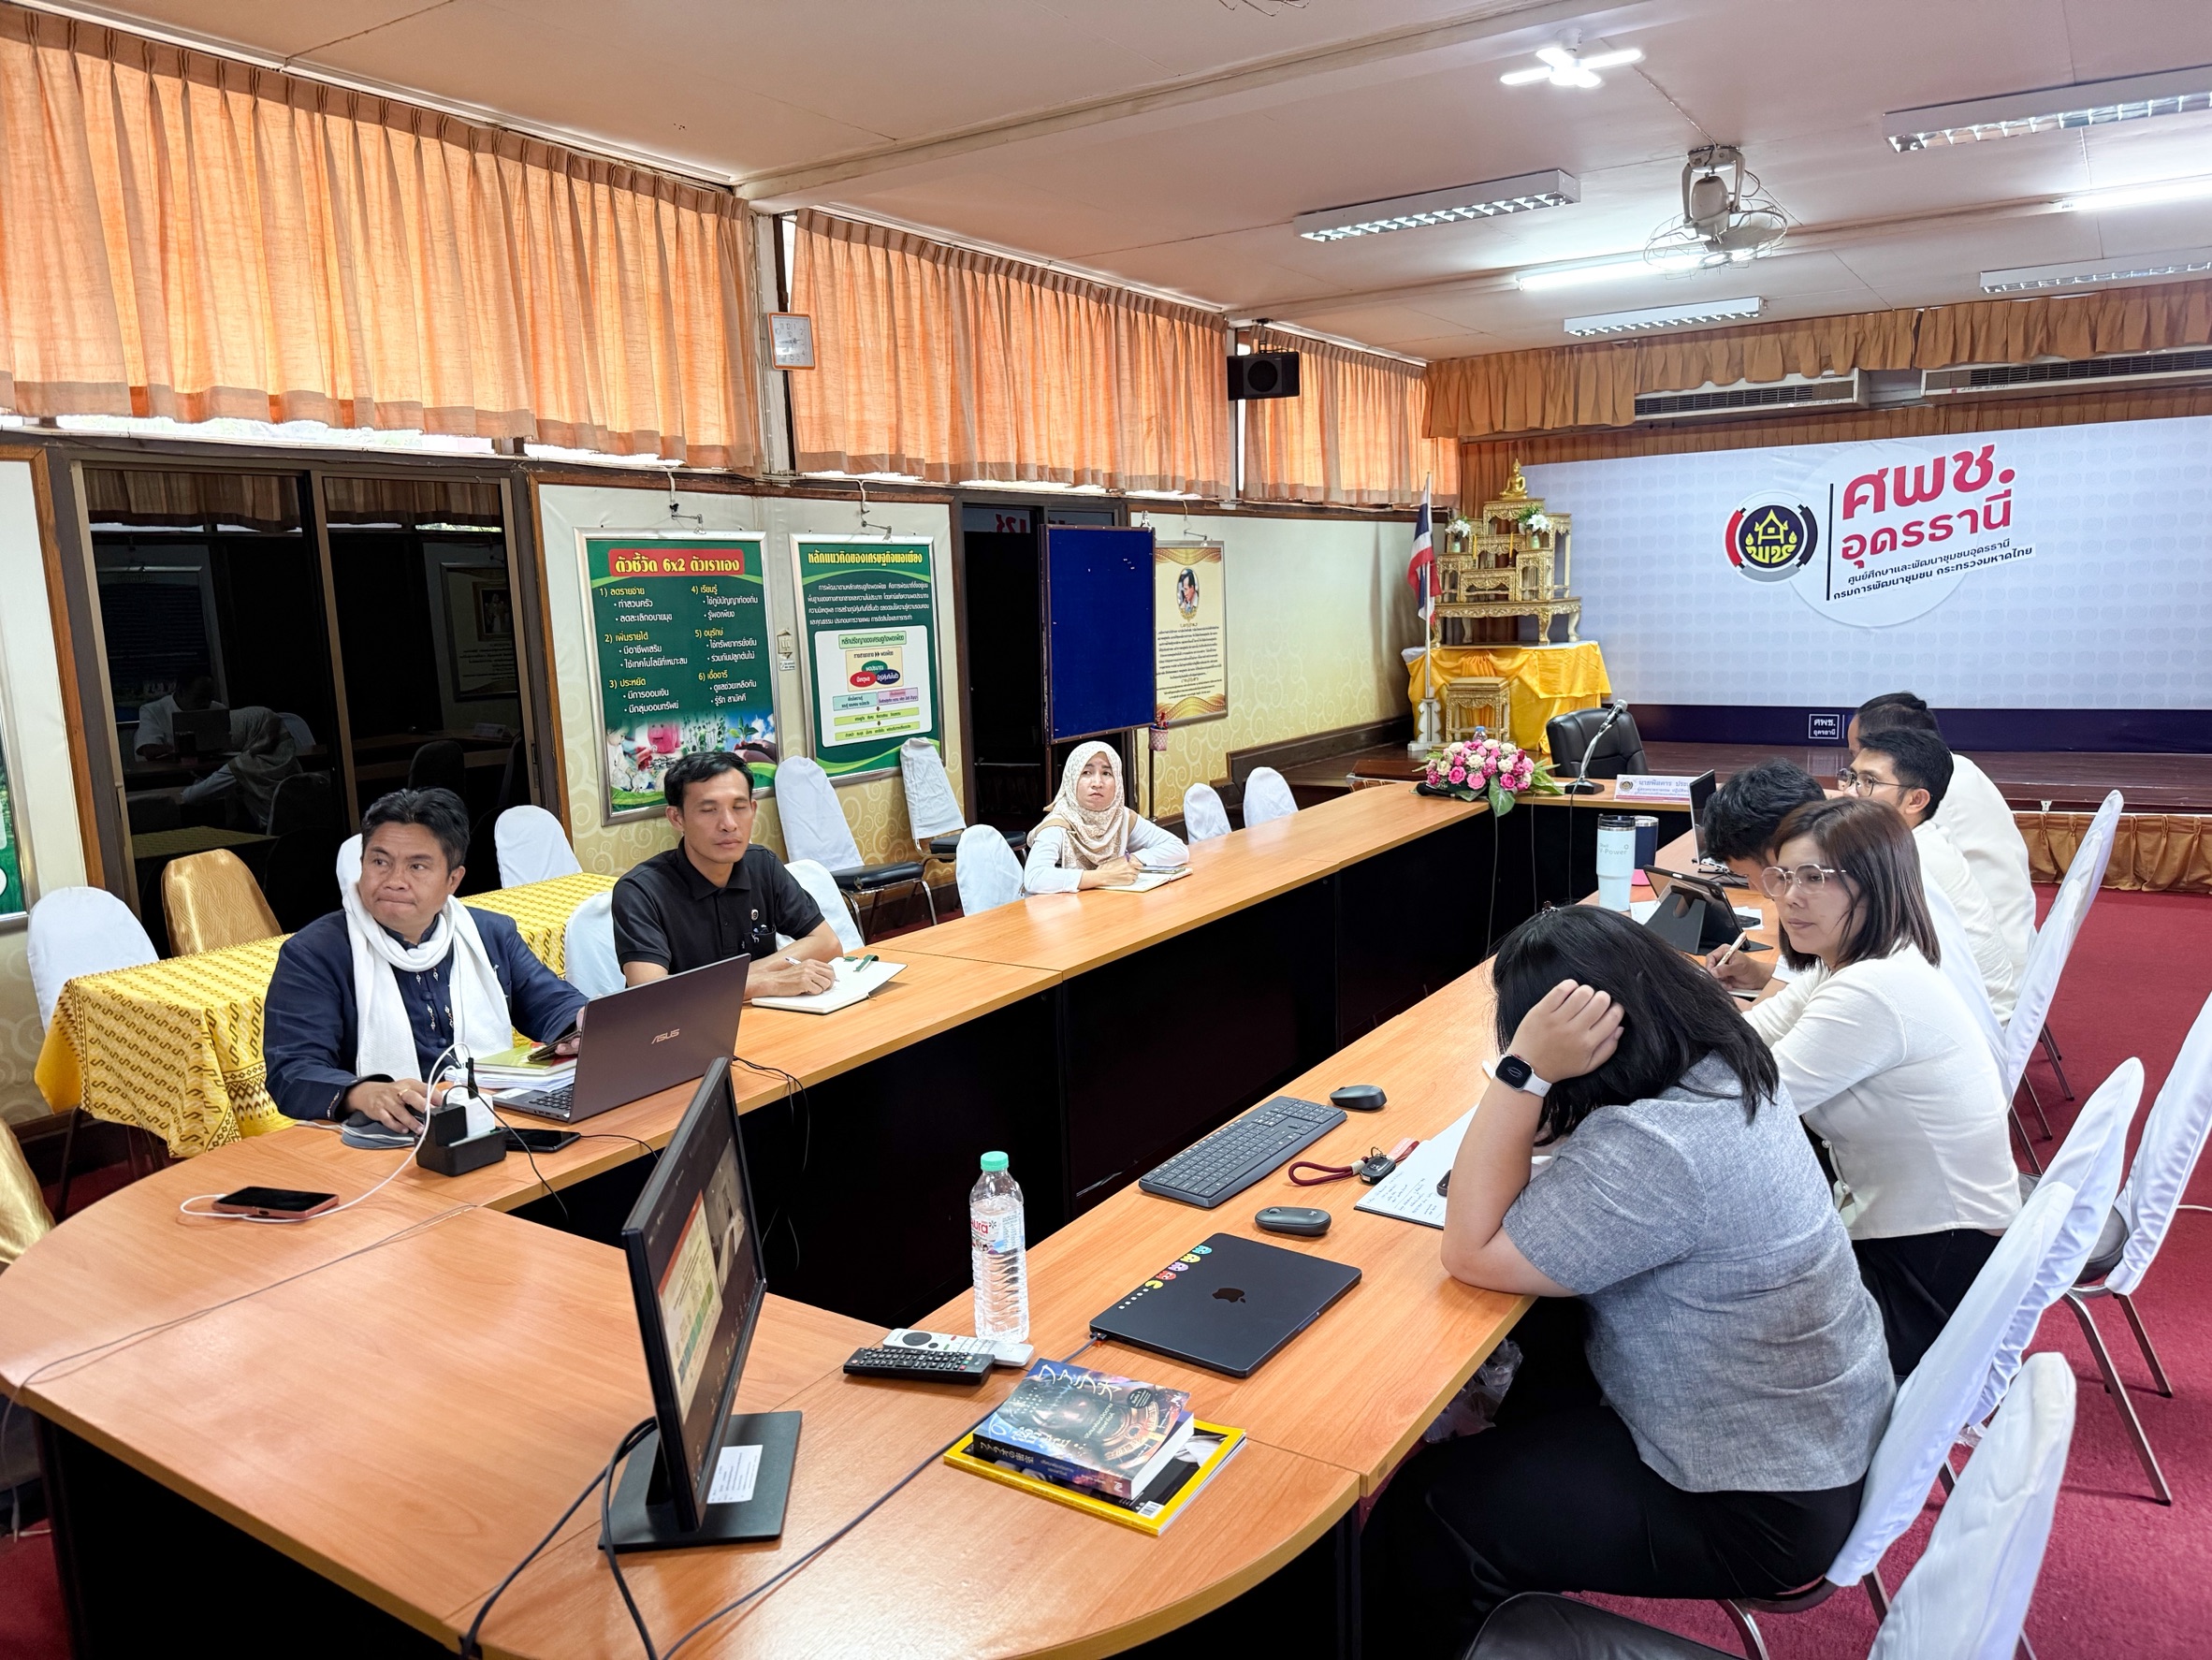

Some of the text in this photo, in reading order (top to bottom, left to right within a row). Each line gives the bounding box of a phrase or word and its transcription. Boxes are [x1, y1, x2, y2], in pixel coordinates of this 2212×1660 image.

[1842, 444, 2016, 521] ศพช.
[1841, 488, 2012, 570] อุดรธานี
[615, 552, 740, 573] ตัวชี้วัด 6x2 ตัวเราเอง
[1847, 537, 2011, 585] ศูนย์ศึกษาและพัฒนาชุมชนอุดรธานี
[1833, 546, 2033, 600] กรมการพัฒนาชุมชน กระทรวงมหาดไทย
[600, 585, 646, 598] 1) ลดรายจ่าย
[691, 584, 718, 595] 4) เรียนรู้
[604, 630, 649, 644] 2) เพิ่มรายได้
[694, 629, 703, 639] 5)
[609, 677, 647, 690] 3) ประหยัด
[698, 672, 706, 682] 6)
[1813, 718, 1836, 727] ศพช.
[651, 1027, 680, 1044] ASUS
